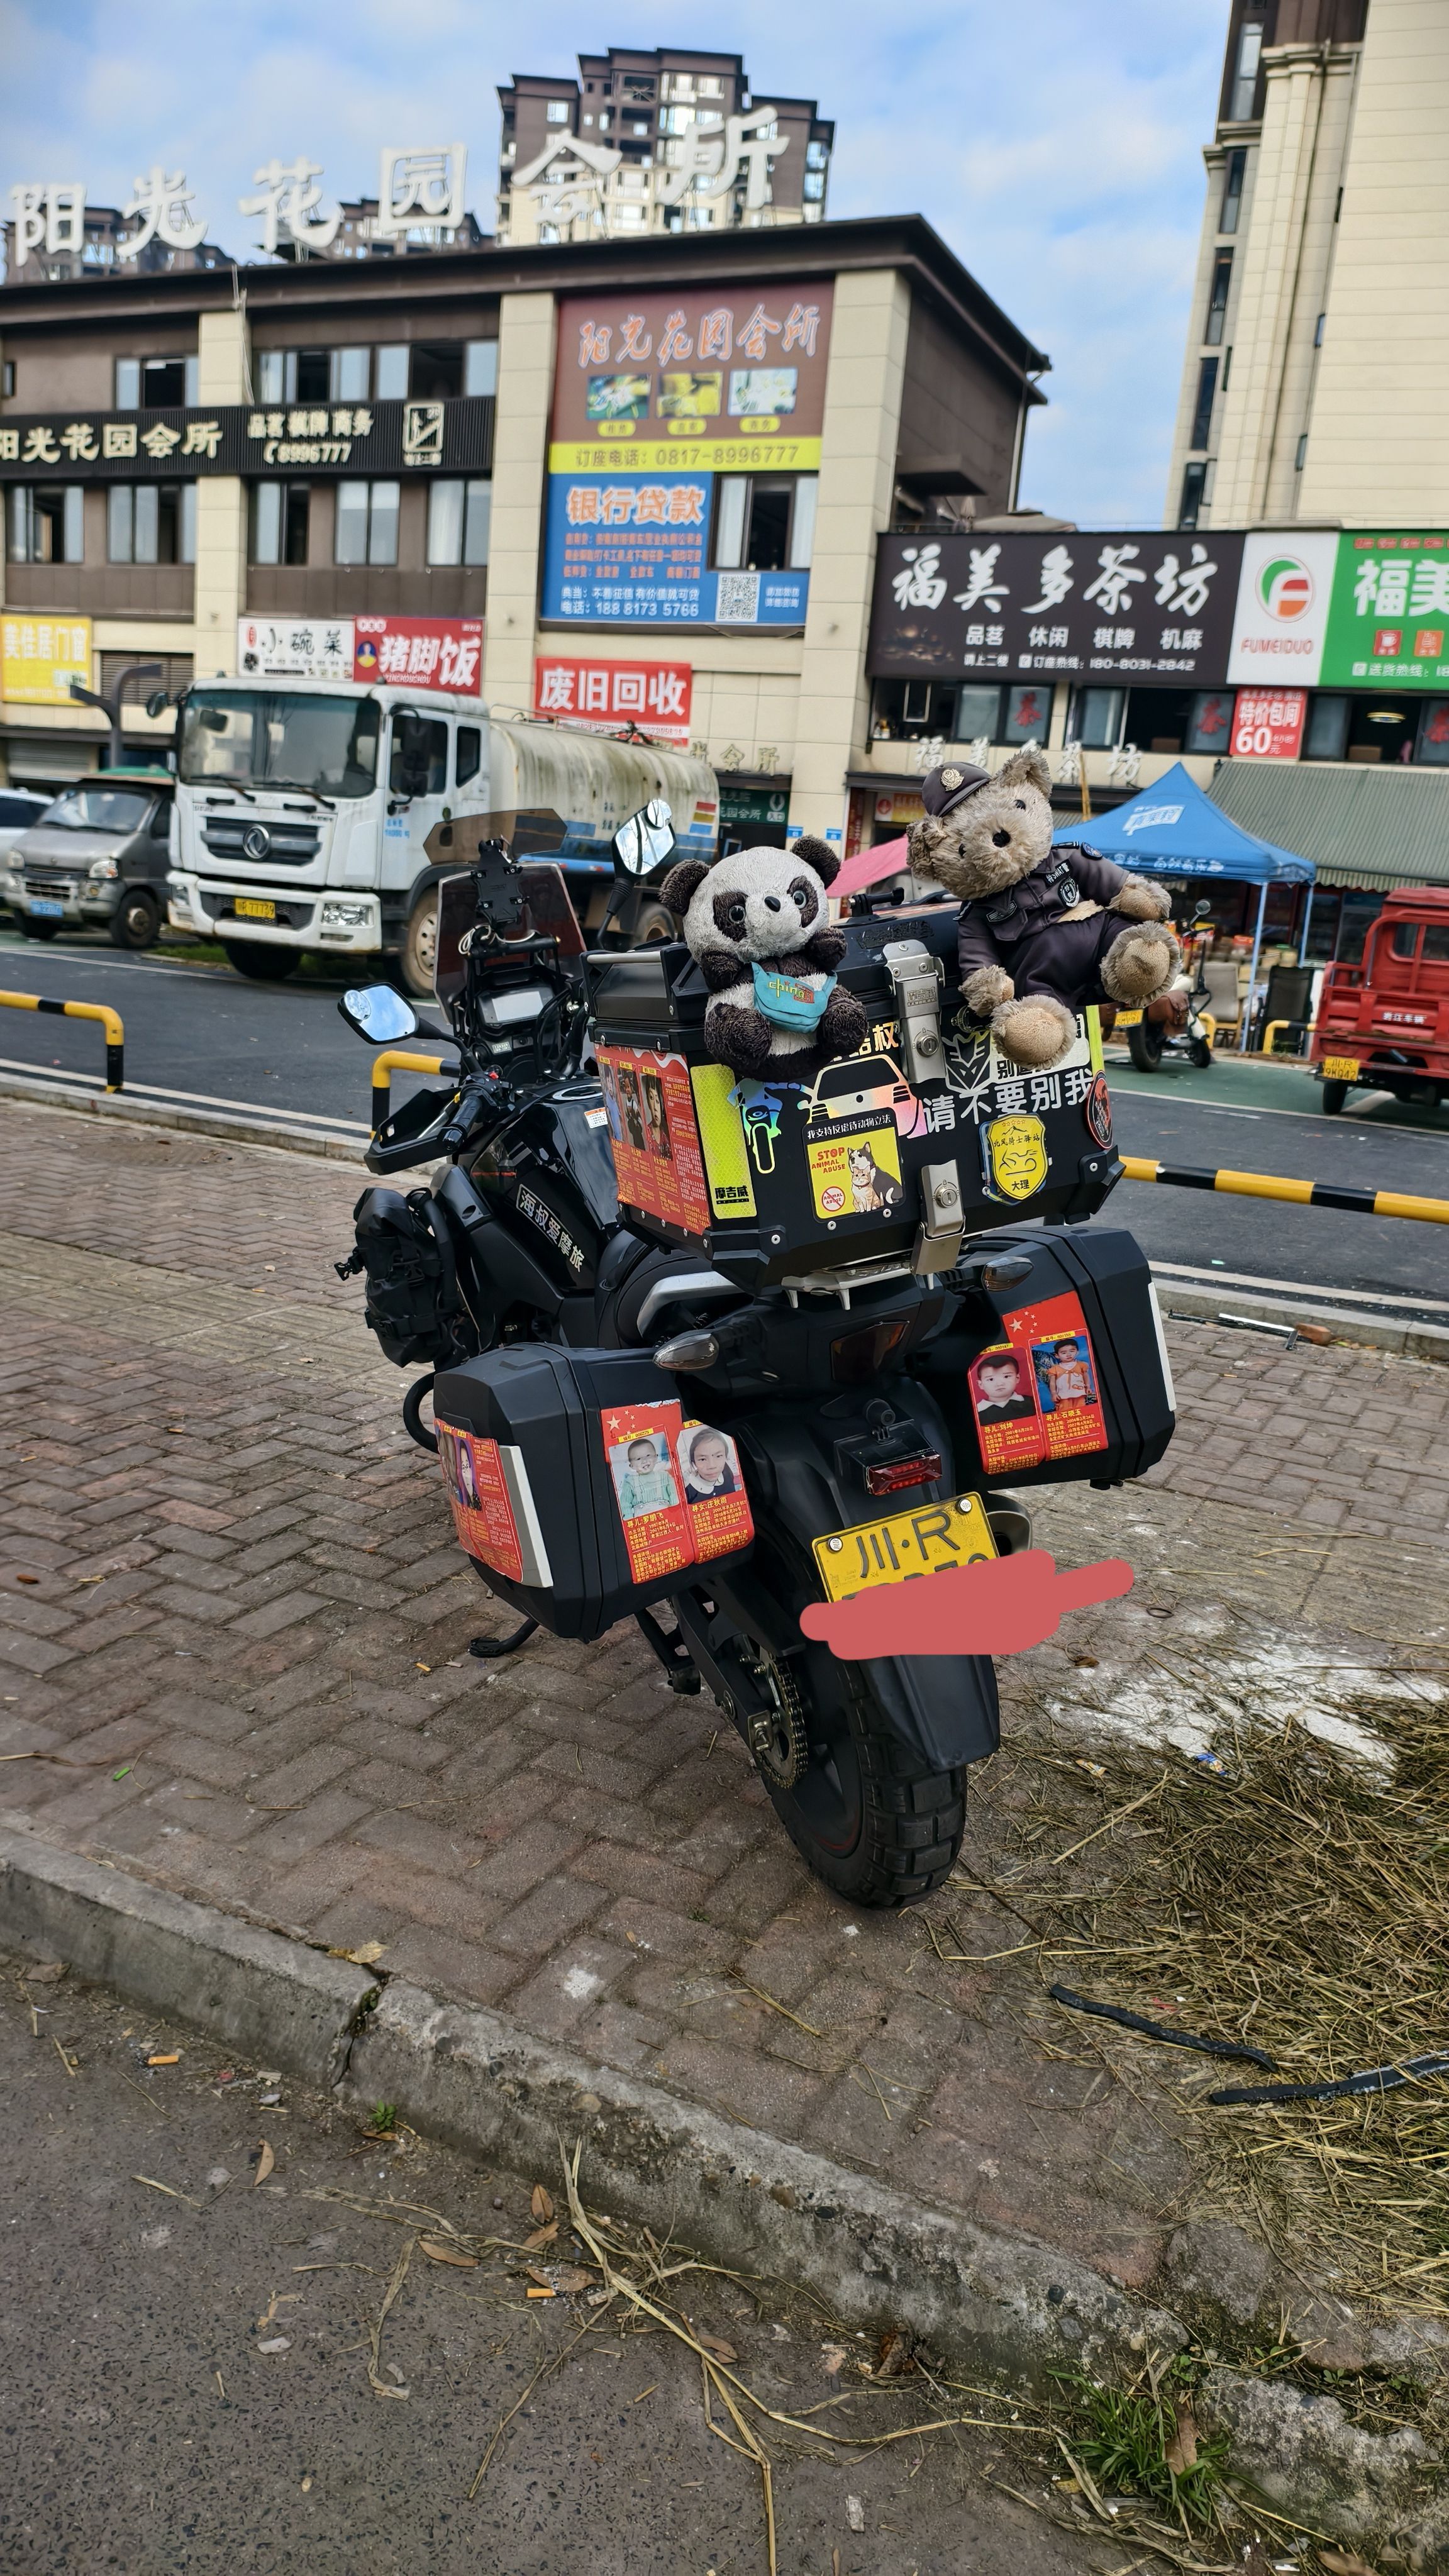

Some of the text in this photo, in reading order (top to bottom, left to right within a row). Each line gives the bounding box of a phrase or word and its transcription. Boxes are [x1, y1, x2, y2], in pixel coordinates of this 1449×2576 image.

[11, 106, 791, 267] 阳光花园会所
[578, 303, 820, 369] 阳光花园会所
[277, 442, 352, 464] 8996777
[655, 445, 799, 466] 0817-8996777
[567, 485, 706, 526] 银行贷款
[891, 542, 1218, 617] 福美多茶坊
[1353, 558, 1449, 617] 福美
[596, 602, 619, 616] 188
[623, 602, 657, 616] 8173
[262, 628, 342, 657] 小碗菜
[965, 625, 1204, 650] 品茗 休闲 棋牌 机麻
[379, 634, 481, 687] 猪脚饭
[1089, 657, 1196, 671] 180-8031-2842
[540, 665, 687, 716] 废旧回收
[1236, 726, 1272, 754] 60
[769, 978, 805, 999] china
[923, 1068, 1094, 1133] 请不要别我
[807, 1114, 891, 1140] 我支持反虐待动物立法
[811, 1158, 840, 1170] ANIMAL
[817, 1146, 845, 1161] STOP
[823, 1163, 846, 1174] ABUSE
[1011, 1179, 1030, 1191] 大理
